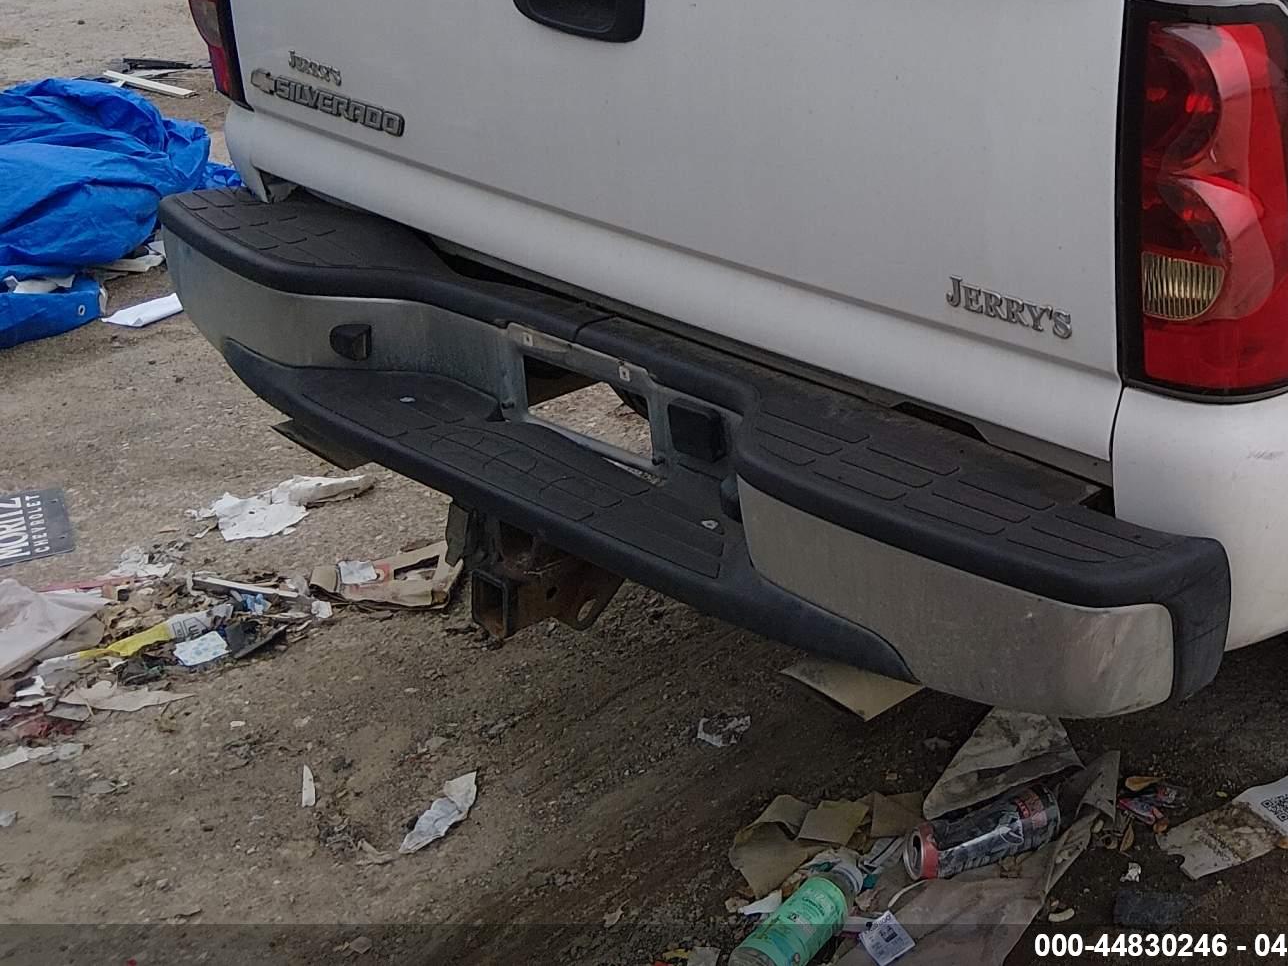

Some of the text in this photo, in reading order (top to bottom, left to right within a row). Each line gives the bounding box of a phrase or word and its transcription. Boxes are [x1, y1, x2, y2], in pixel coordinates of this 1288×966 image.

[274, 76, 405, 136] SILVERADO
[946, 274, 1073, 339] JERRY'S
[24, 494, 51, 554] CHEVROLET
